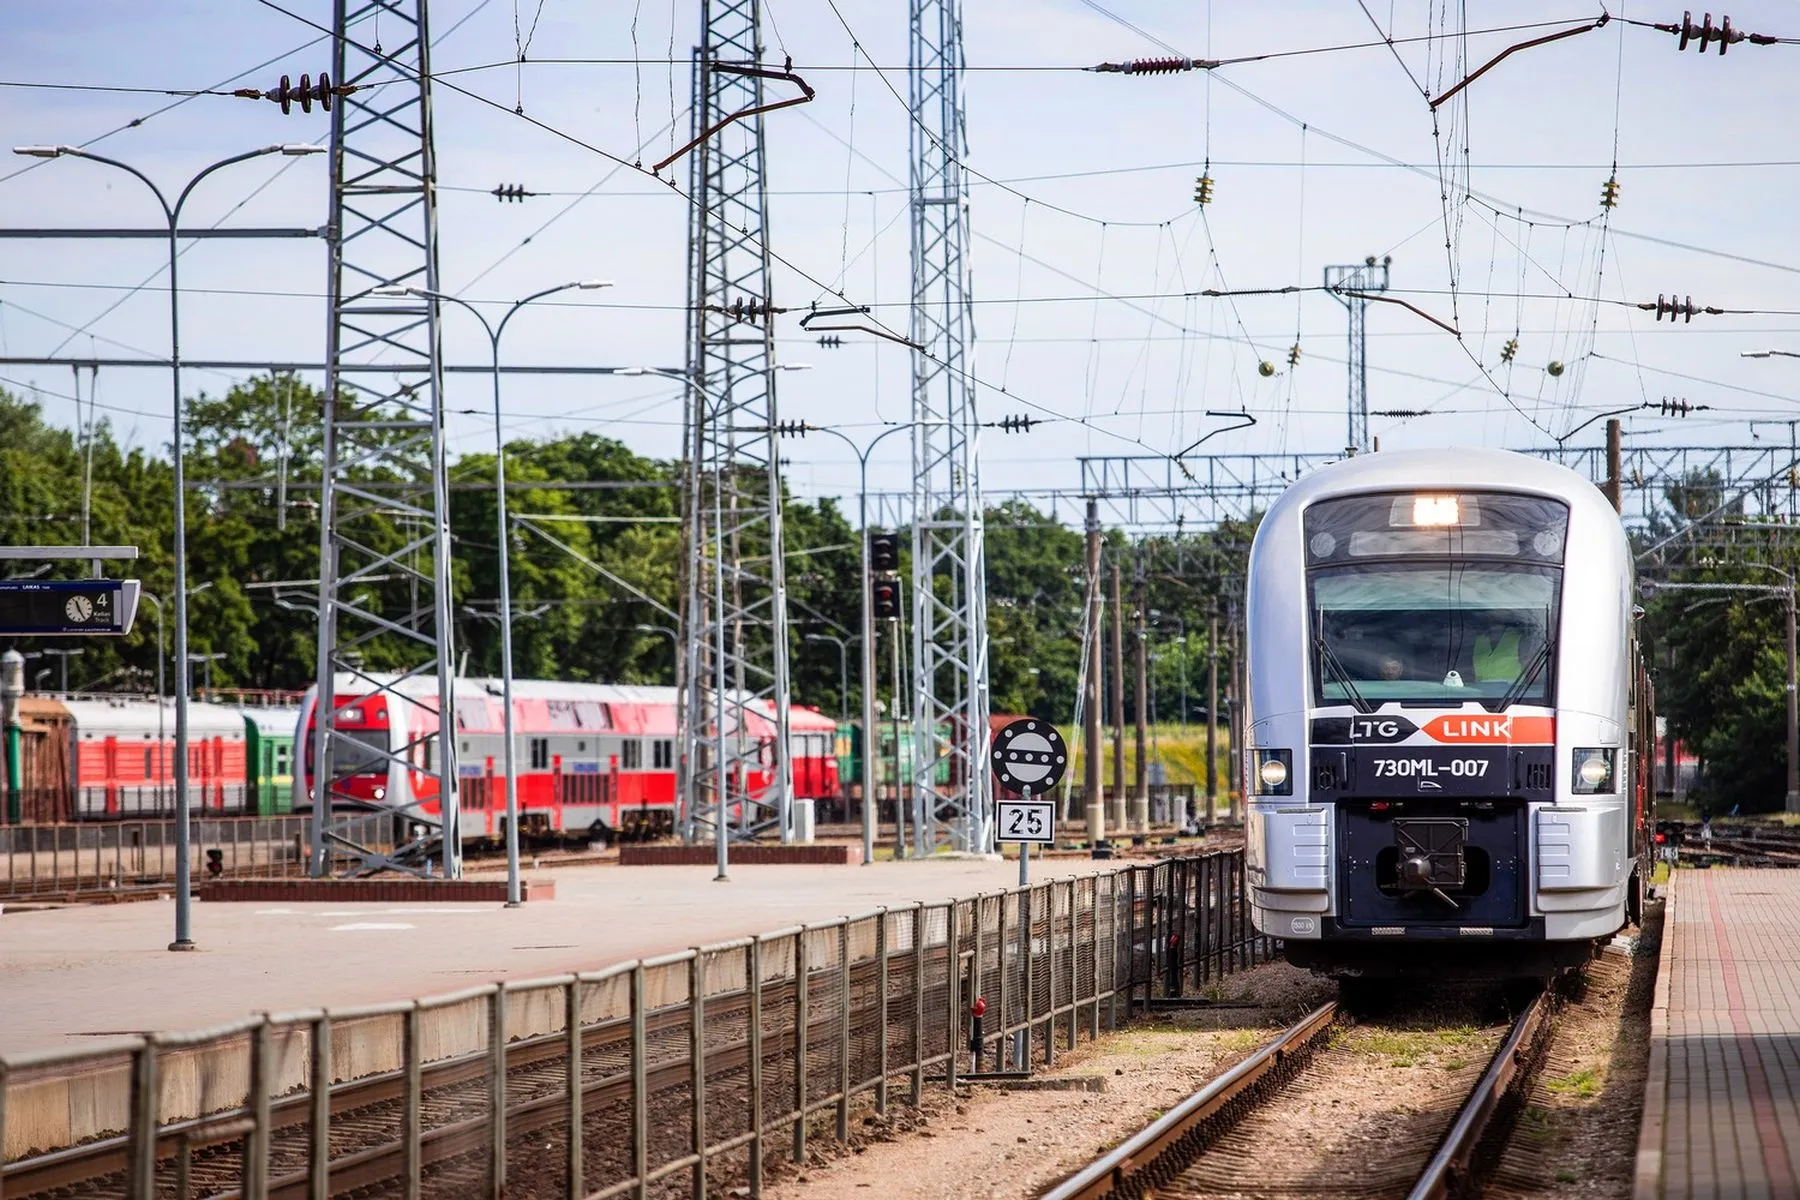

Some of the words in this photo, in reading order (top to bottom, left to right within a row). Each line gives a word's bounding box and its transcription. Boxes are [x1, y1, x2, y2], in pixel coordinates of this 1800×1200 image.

[96, 593, 108, 607] 4
[1349, 721, 1399, 739] LTG
[1443, 721, 1512, 739] LINK
[1374, 759, 1489, 777] 730ML-007
[1009, 809, 1042, 834] 25
